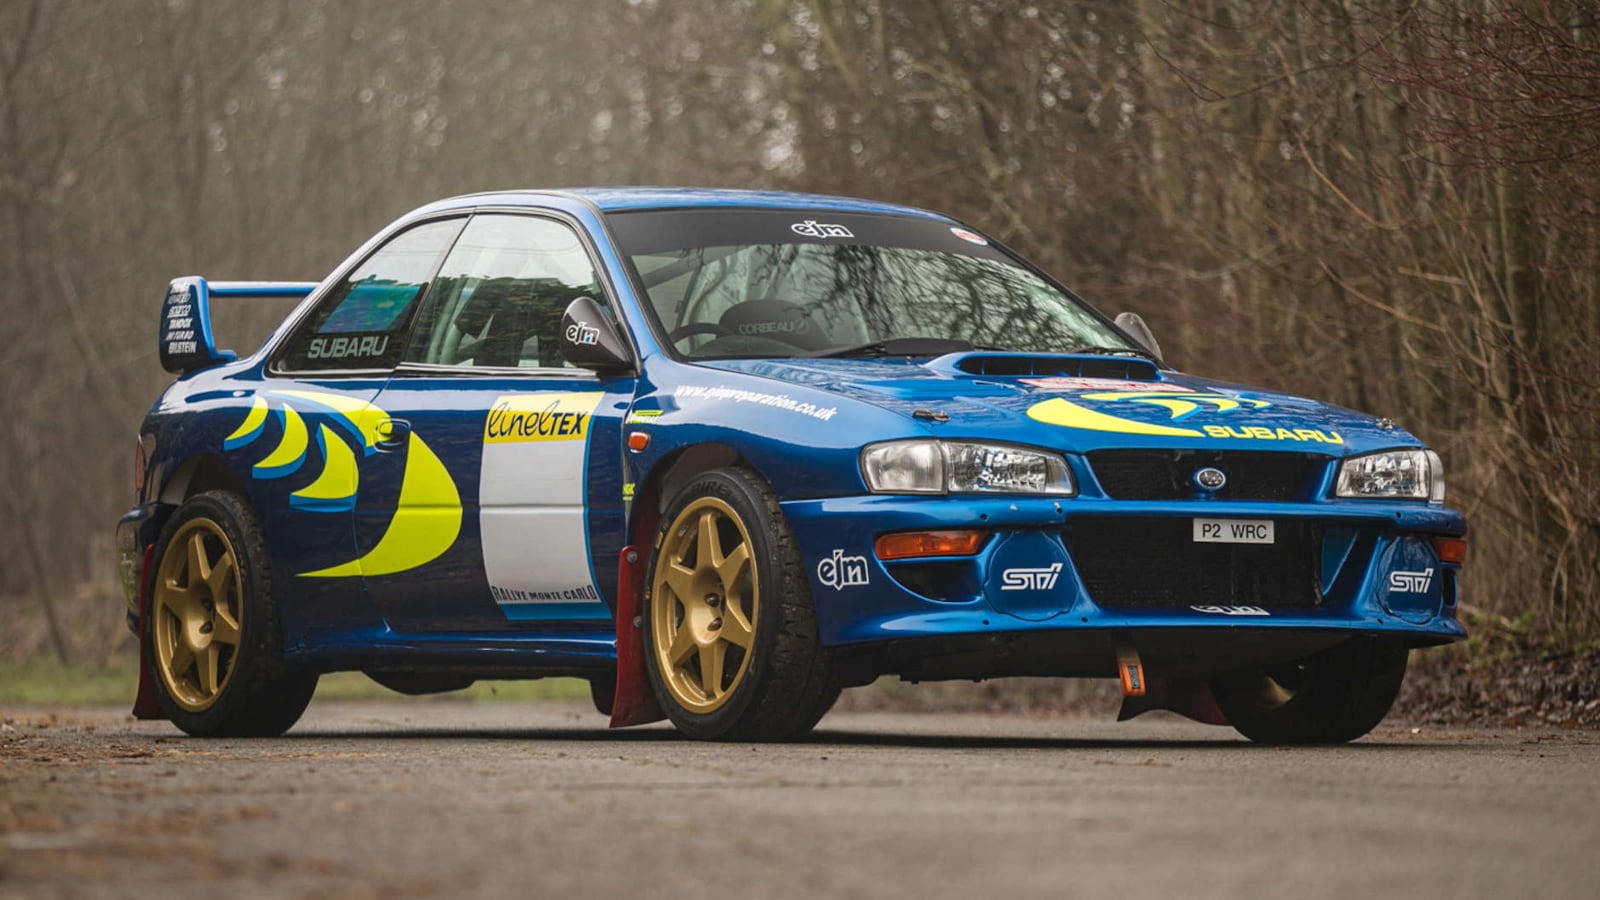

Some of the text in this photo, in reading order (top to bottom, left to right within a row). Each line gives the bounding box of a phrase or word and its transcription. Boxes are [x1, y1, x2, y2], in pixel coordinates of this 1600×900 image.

[791, 220, 855, 238] ejm
[565, 321, 600, 346] ejm
[739, 321, 794, 335] CORBEAU
[307, 335, 389, 359] SUBARU
[1202, 425, 1345, 445] SUBARU
[1202, 523, 1267, 540] P2 WRC
[817, 549, 870, 591] ejm
[491, 585, 527, 602] RALLYE
